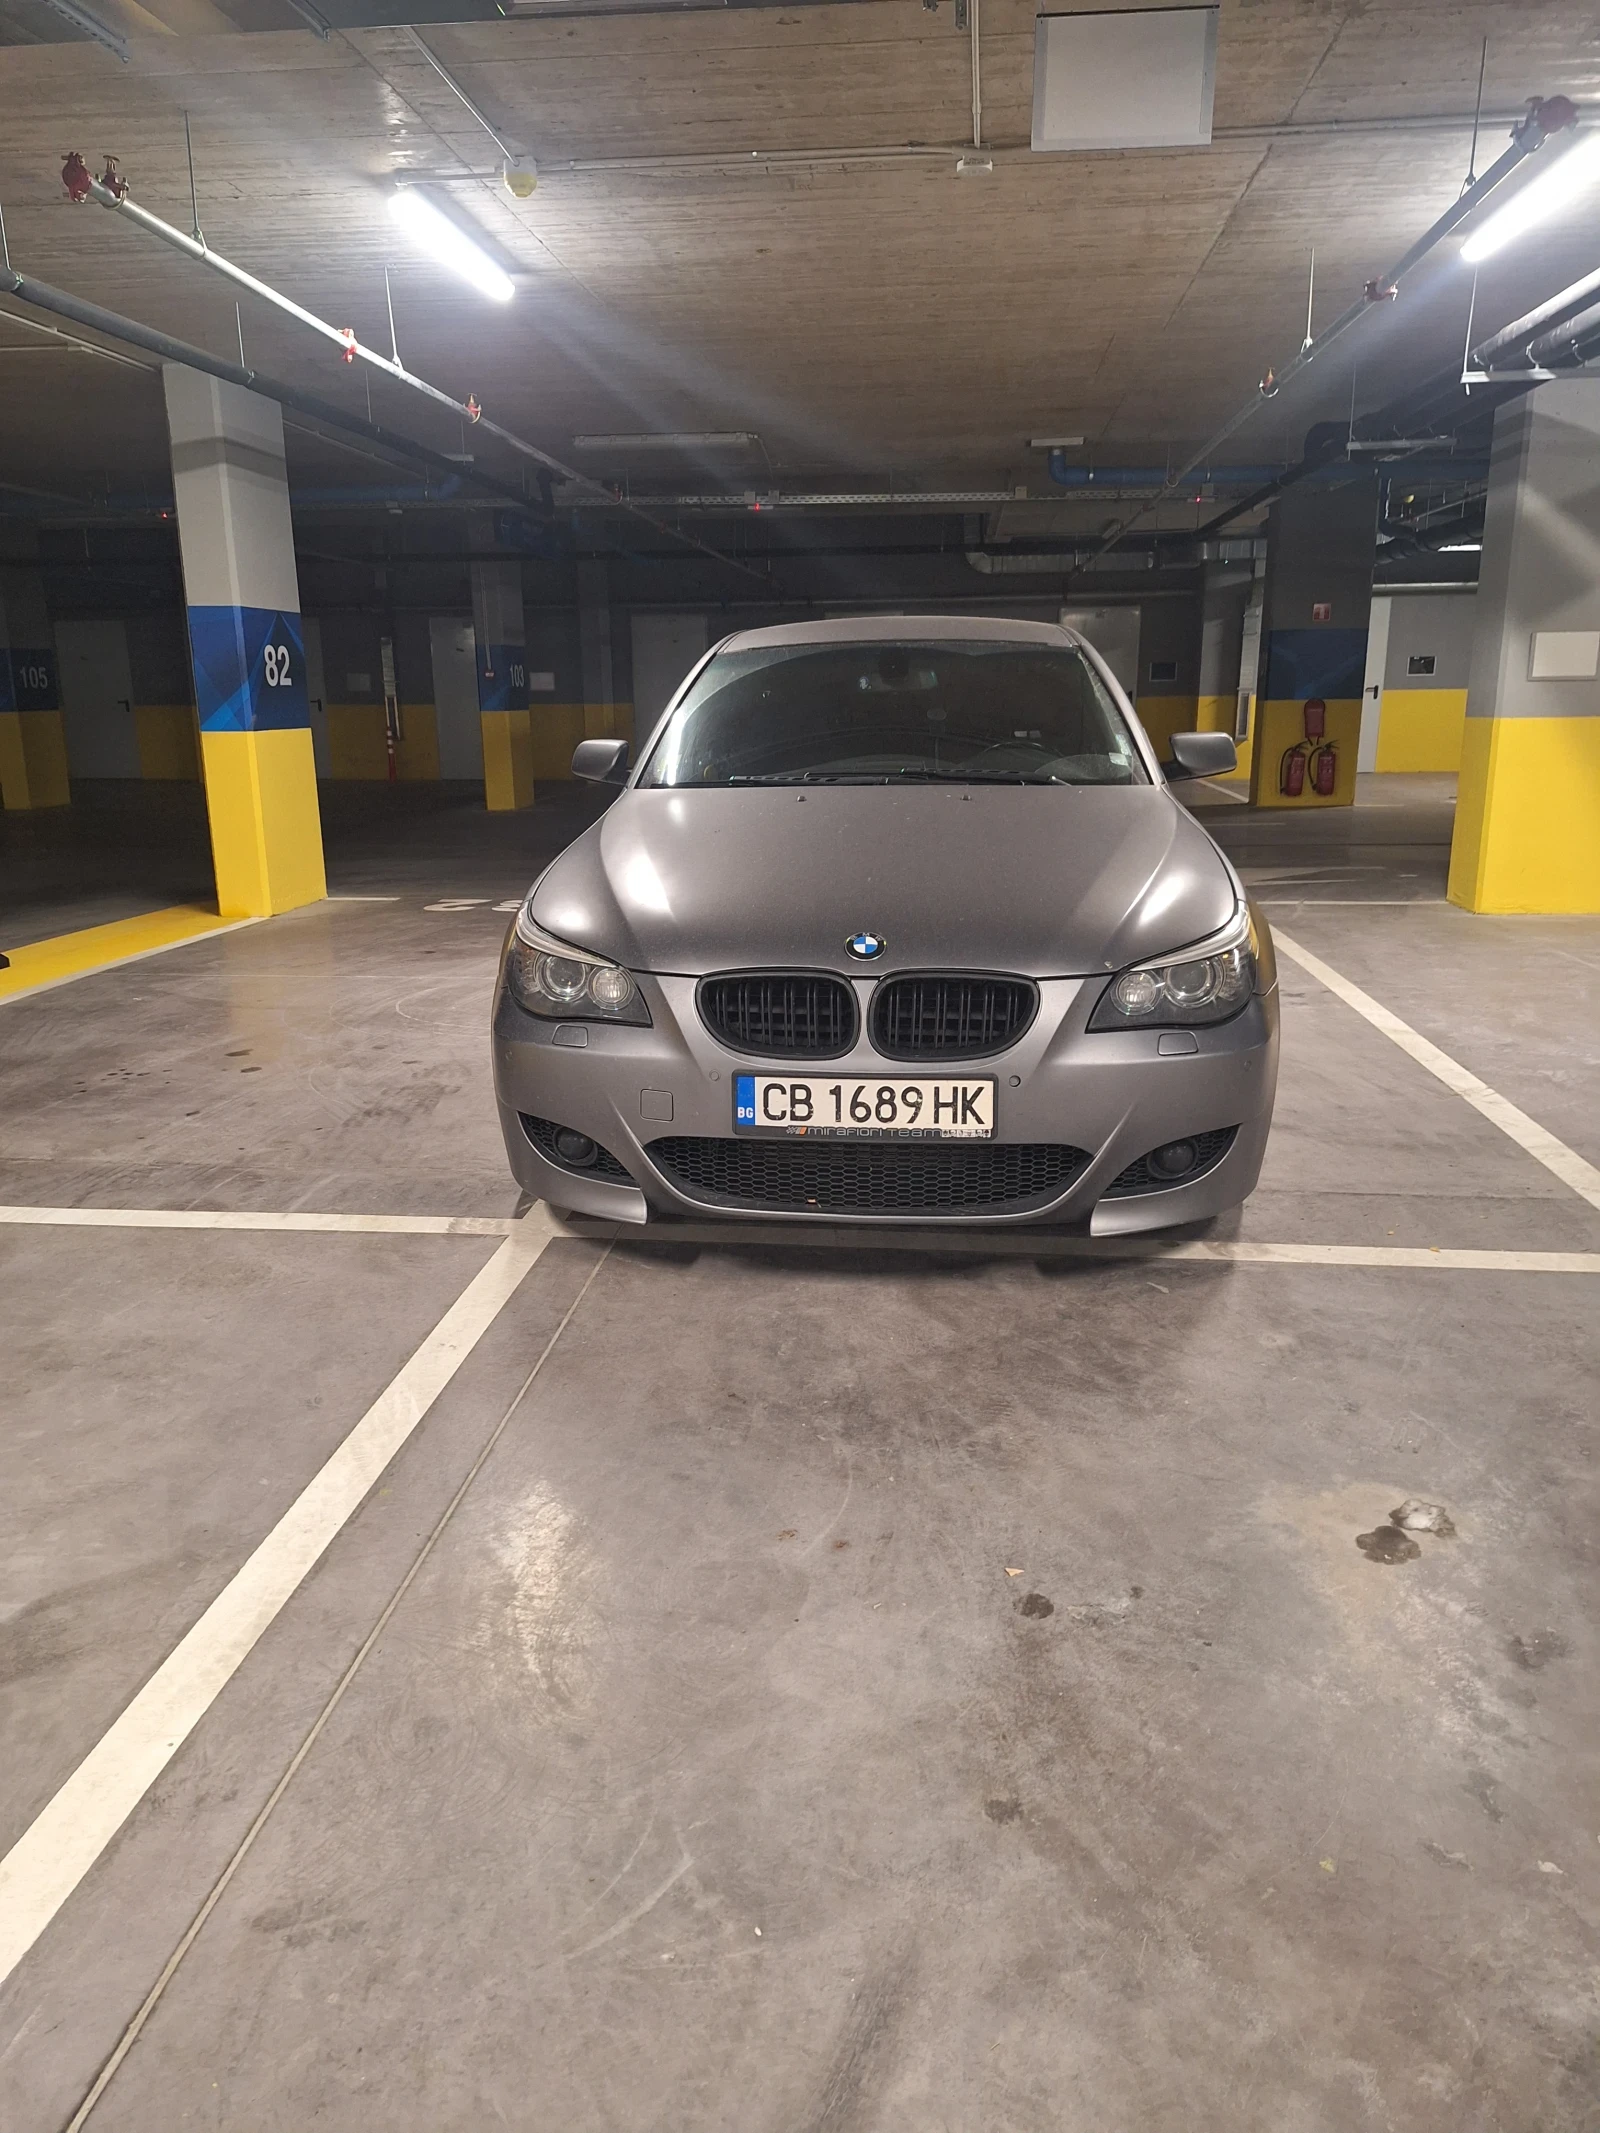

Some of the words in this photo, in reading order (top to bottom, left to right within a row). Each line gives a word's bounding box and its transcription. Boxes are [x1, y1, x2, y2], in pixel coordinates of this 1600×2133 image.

[20, 666, 48, 689] 105
[264, 644, 292, 687] 82
[509, 664, 525, 688] 103
[737, 1107, 754, 1118] BG
[762, 1083, 814, 1122] CB
[828, 1084, 923, 1124] 1689
[933, 1086, 985, 1125] HK
